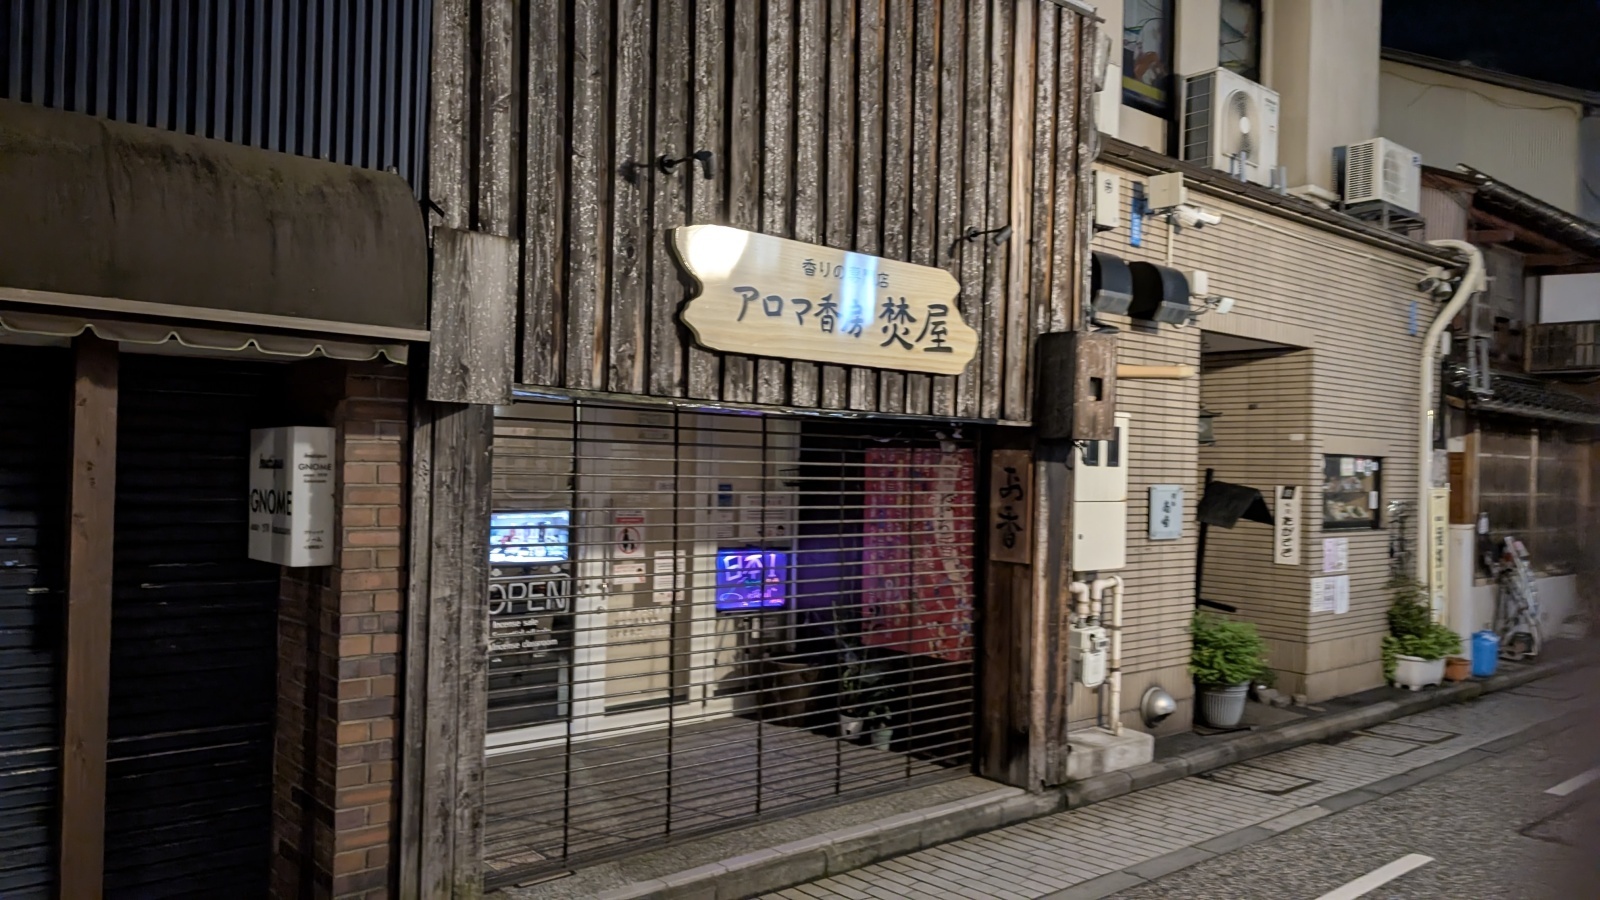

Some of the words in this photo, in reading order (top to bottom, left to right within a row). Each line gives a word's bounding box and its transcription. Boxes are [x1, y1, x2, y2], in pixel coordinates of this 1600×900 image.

[298, 463, 332, 471] GNOME
[251, 488, 292, 516] GNOME
[996, 466, 1024, 549] お香
[488, 581, 565, 614] OPEN
